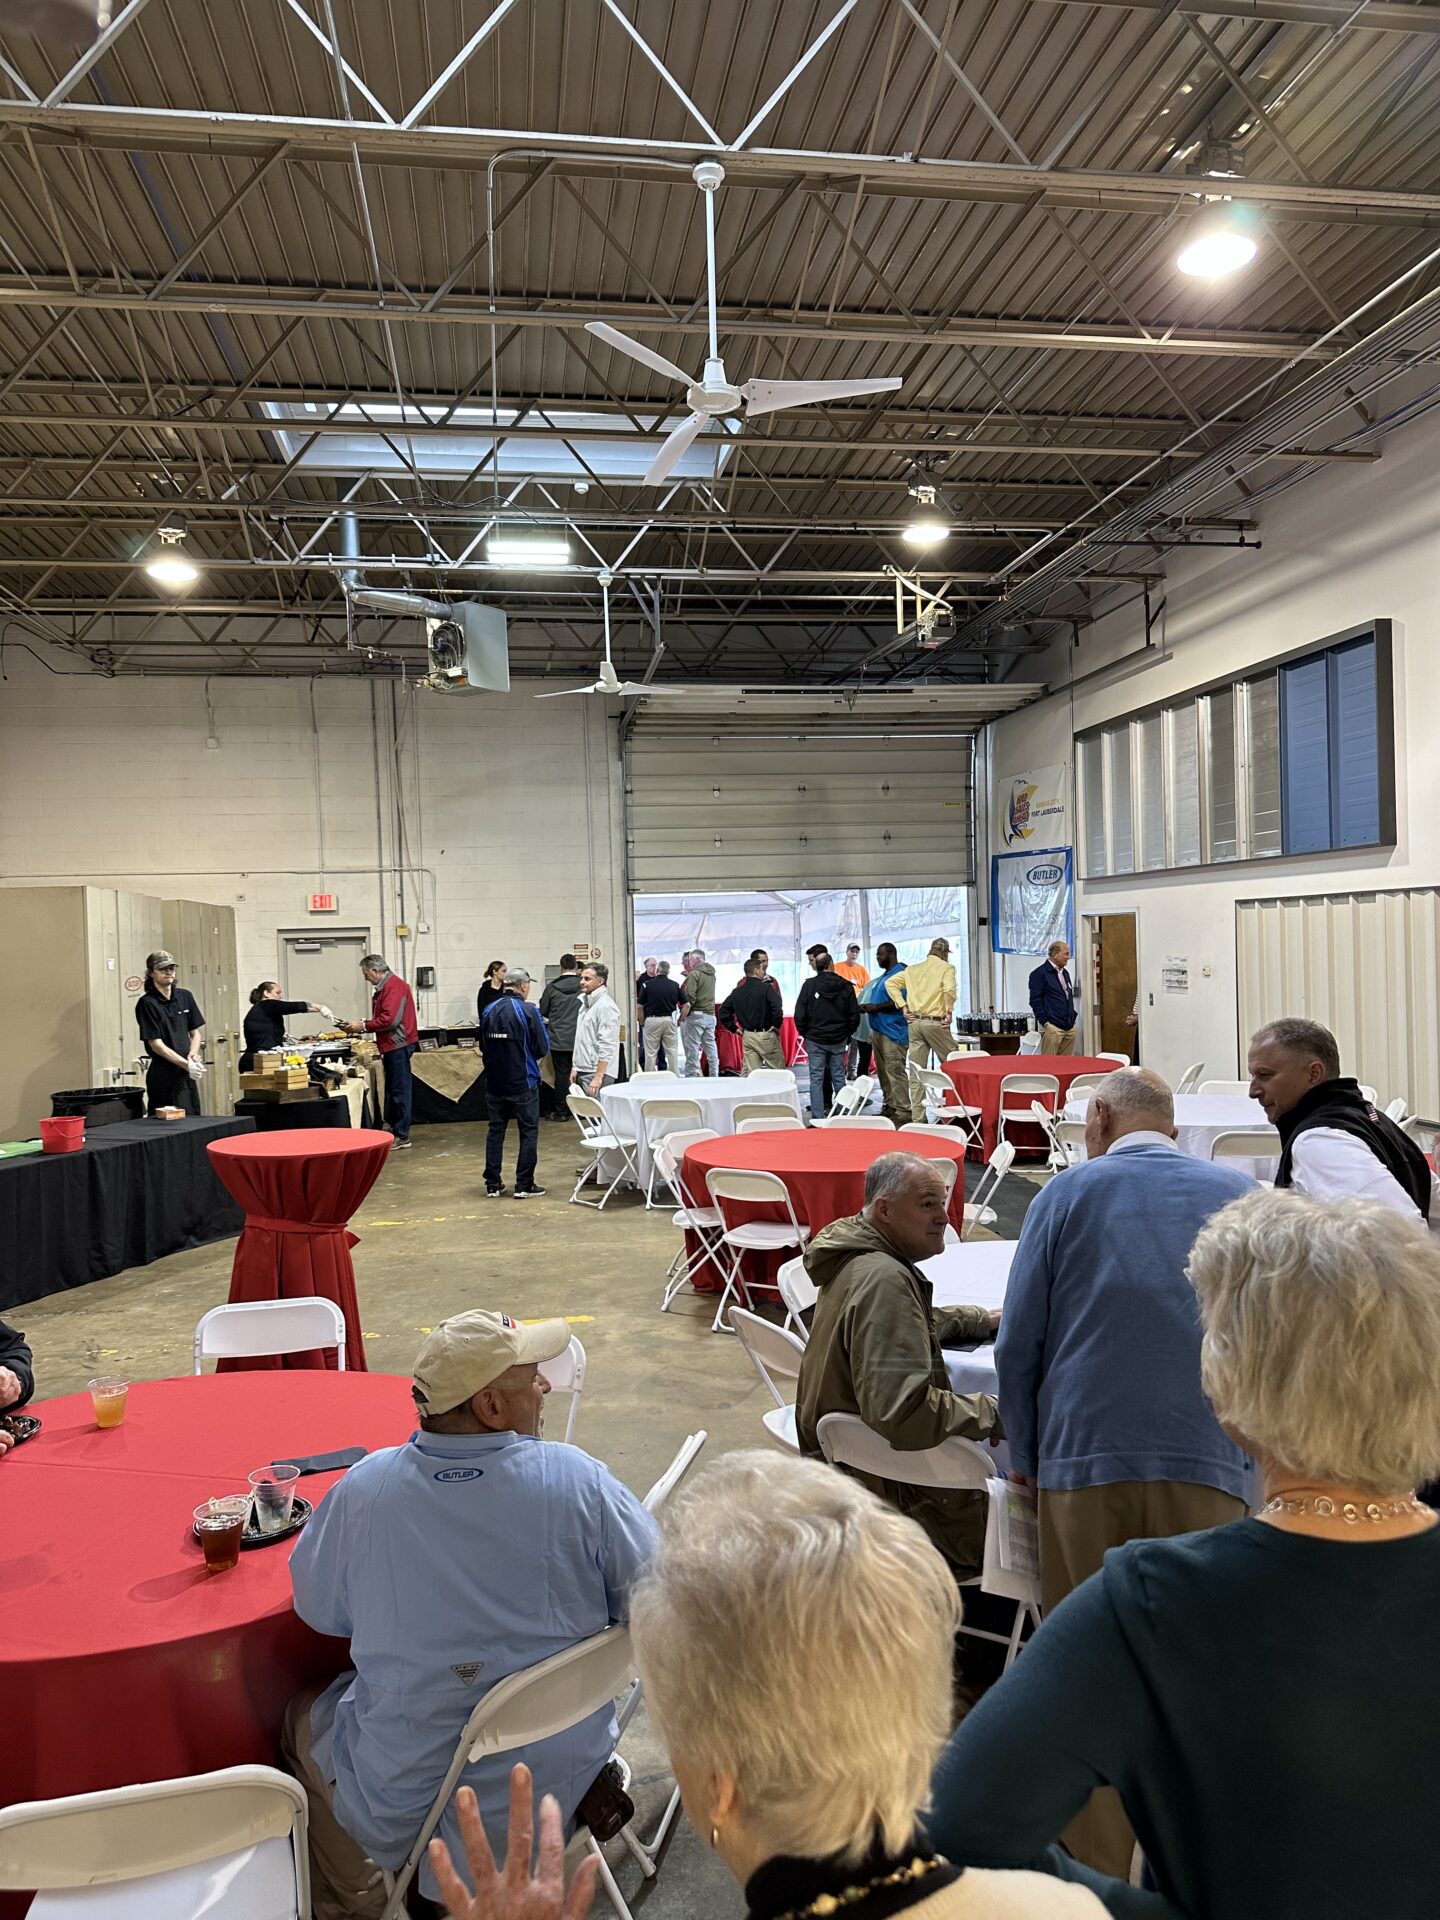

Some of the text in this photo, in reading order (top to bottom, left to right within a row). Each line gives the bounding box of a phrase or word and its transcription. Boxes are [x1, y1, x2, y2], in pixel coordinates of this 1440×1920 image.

[1033, 870, 1057, 880] BUTLER
[313, 895, 331, 908] EXIT
[443, 1471, 474, 1479] BUTLER
